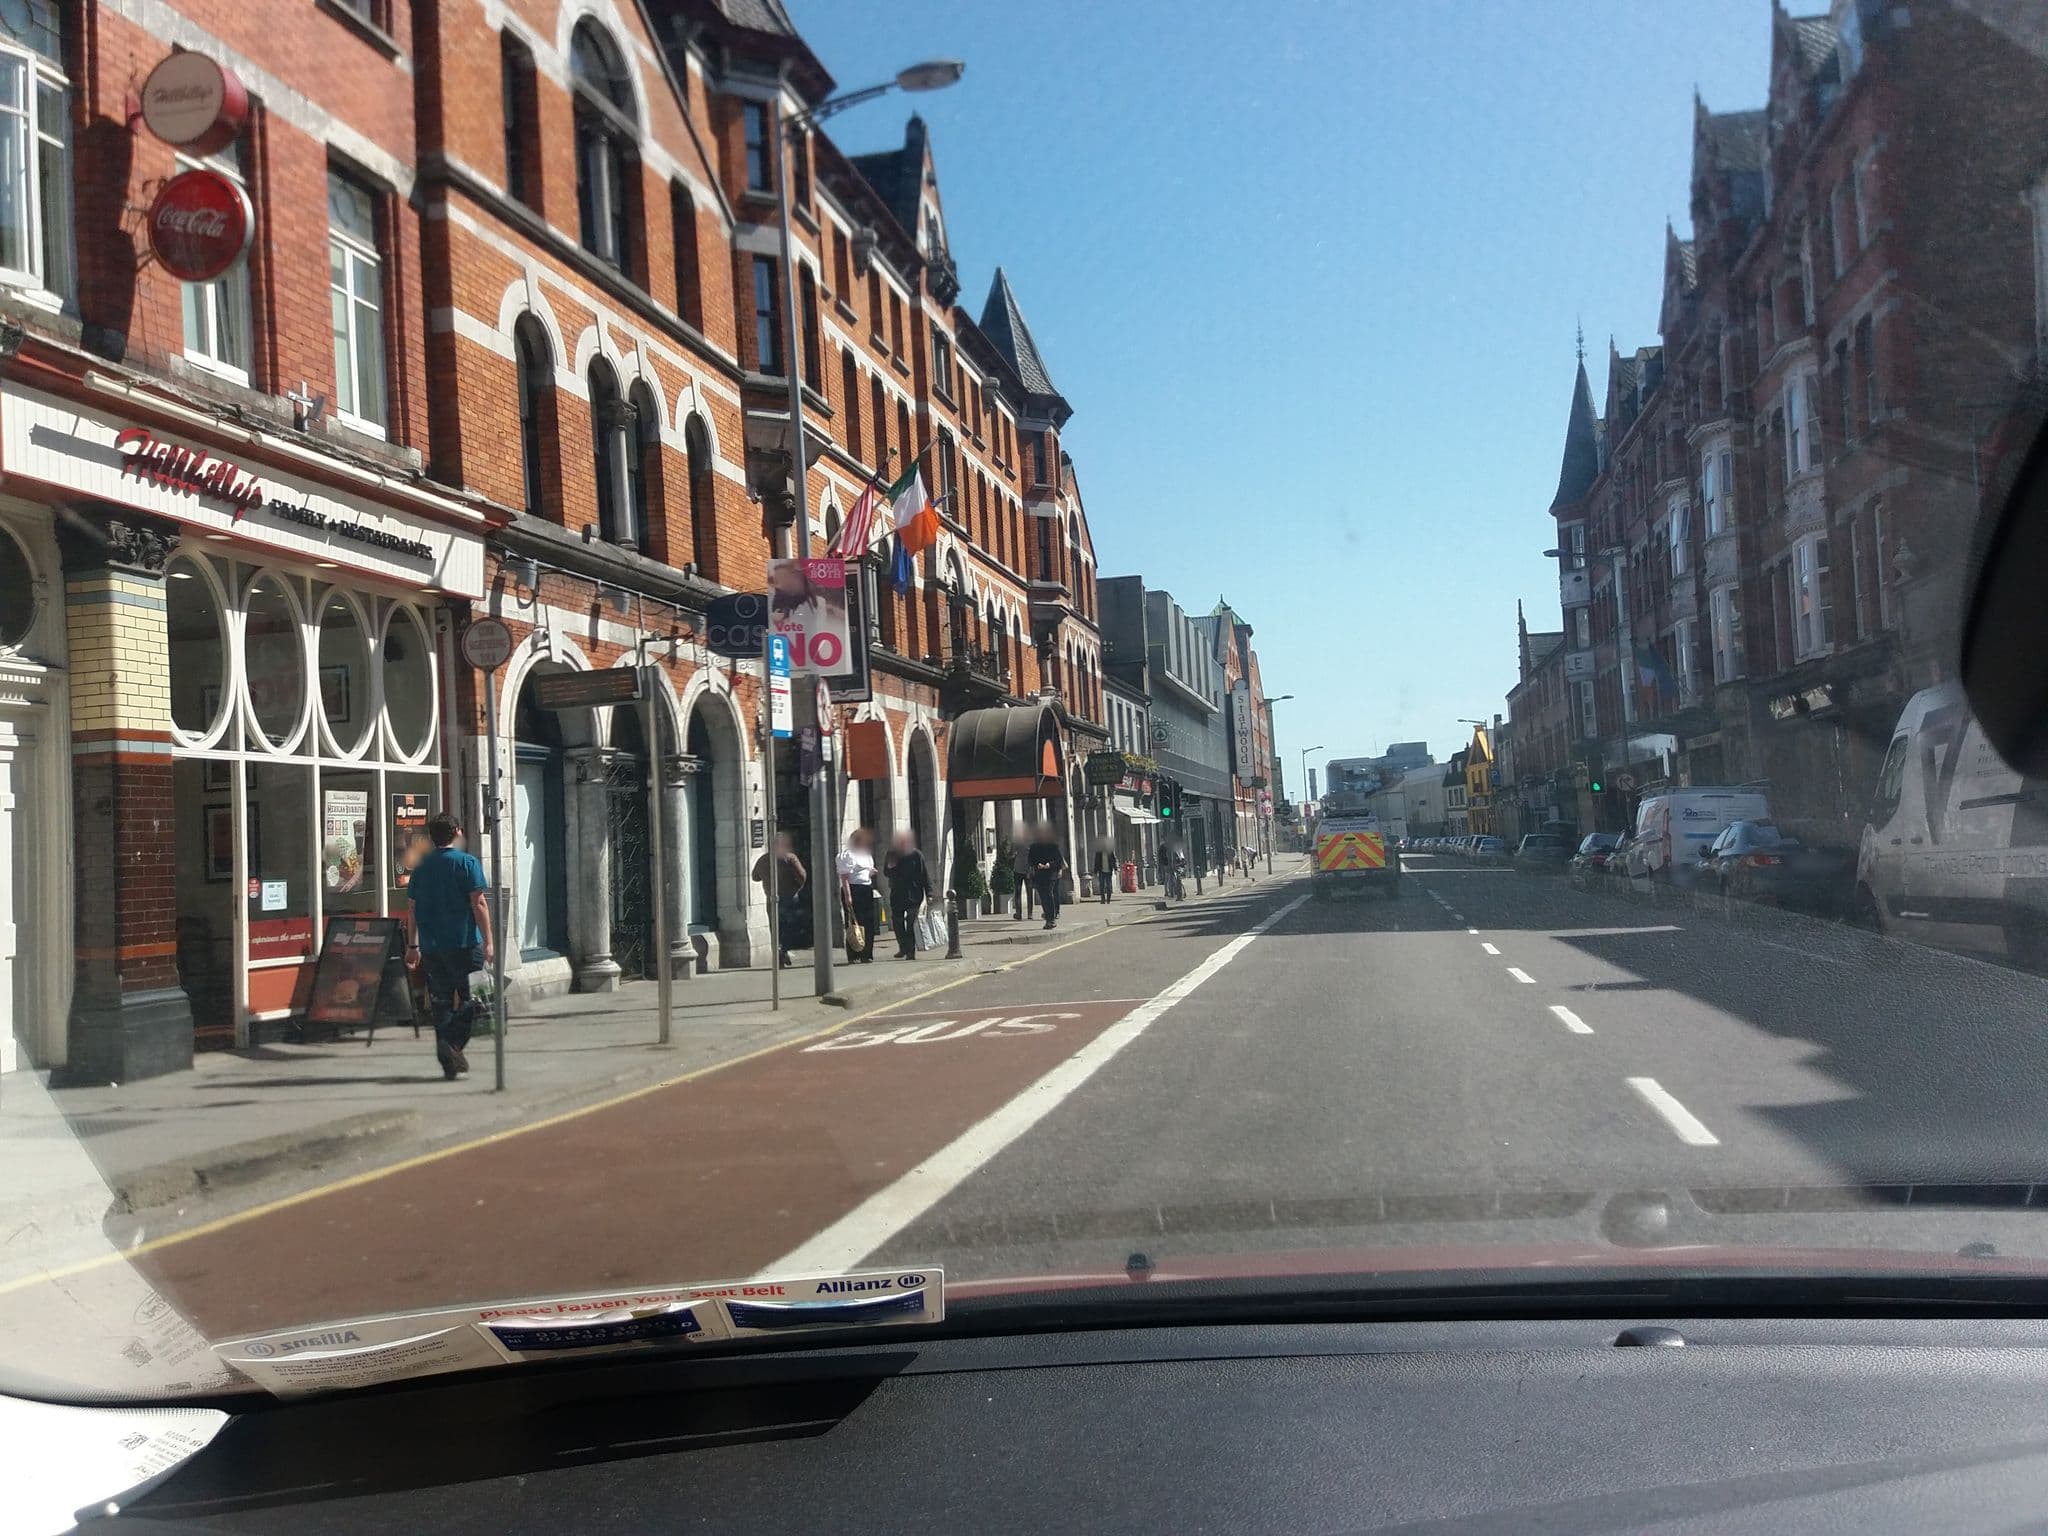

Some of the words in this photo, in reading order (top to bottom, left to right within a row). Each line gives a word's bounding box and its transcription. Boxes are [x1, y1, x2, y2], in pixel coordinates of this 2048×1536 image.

[114, 427, 263, 524] Hillbilly's
[269, 498, 327, 530] FAMILY
[339, 520, 433, 560] RESTAURANTS
[776, 622, 804, 632] Vote
[780, 632, 843, 667] NO
[799, 1013, 1081, 1053] BUS
[479, 1305, 552, 1321] Please
[556, 1298, 628, 1313] Fasten
[633, 1291, 683, 1305] Your
[688, 1286, 737, 1299] Seat
[742, 1284, 785, 1297] Belt
[816, 1276, 892, 1293] Allianz
